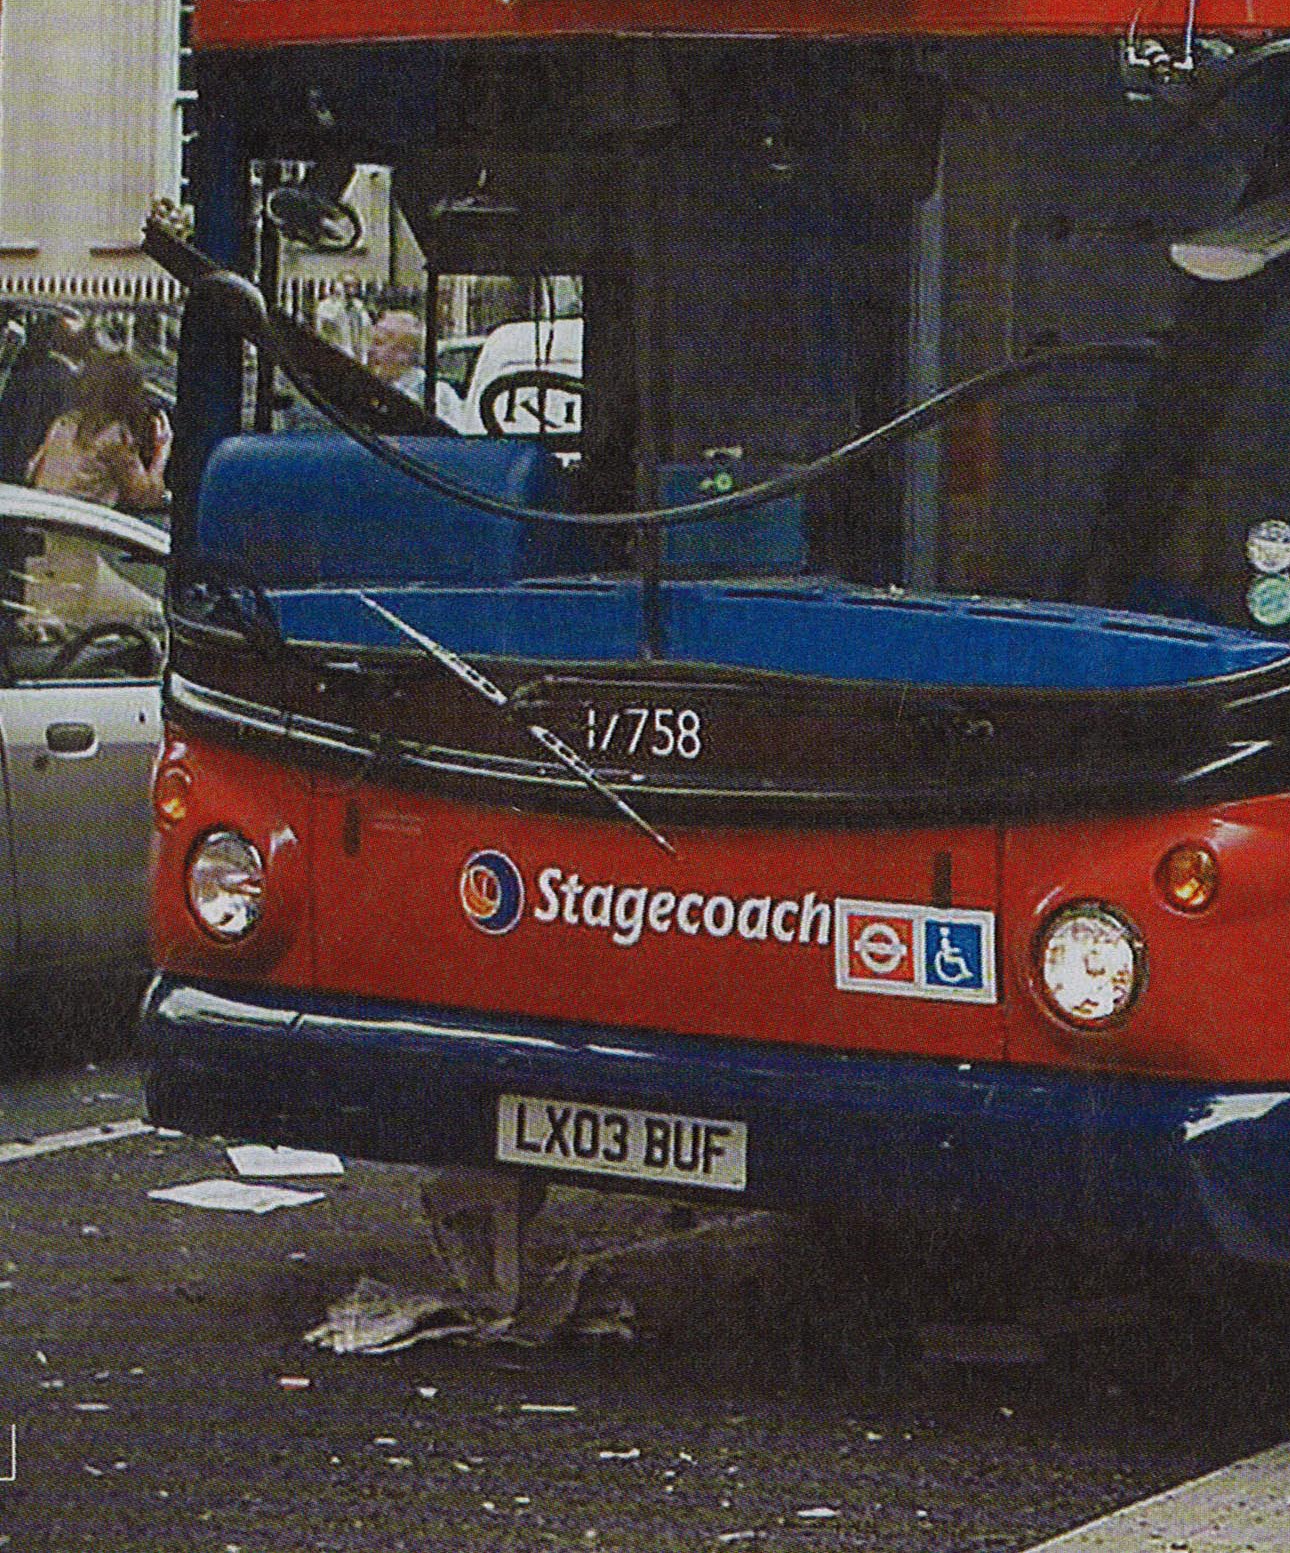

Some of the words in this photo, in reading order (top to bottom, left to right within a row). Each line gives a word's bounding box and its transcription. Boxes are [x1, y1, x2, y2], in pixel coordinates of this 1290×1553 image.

[534, 867, 831, 946] Stagecoach
[516, 1102, 629, 1163] LX03
[644, 1117, 732, 1174] BUF
